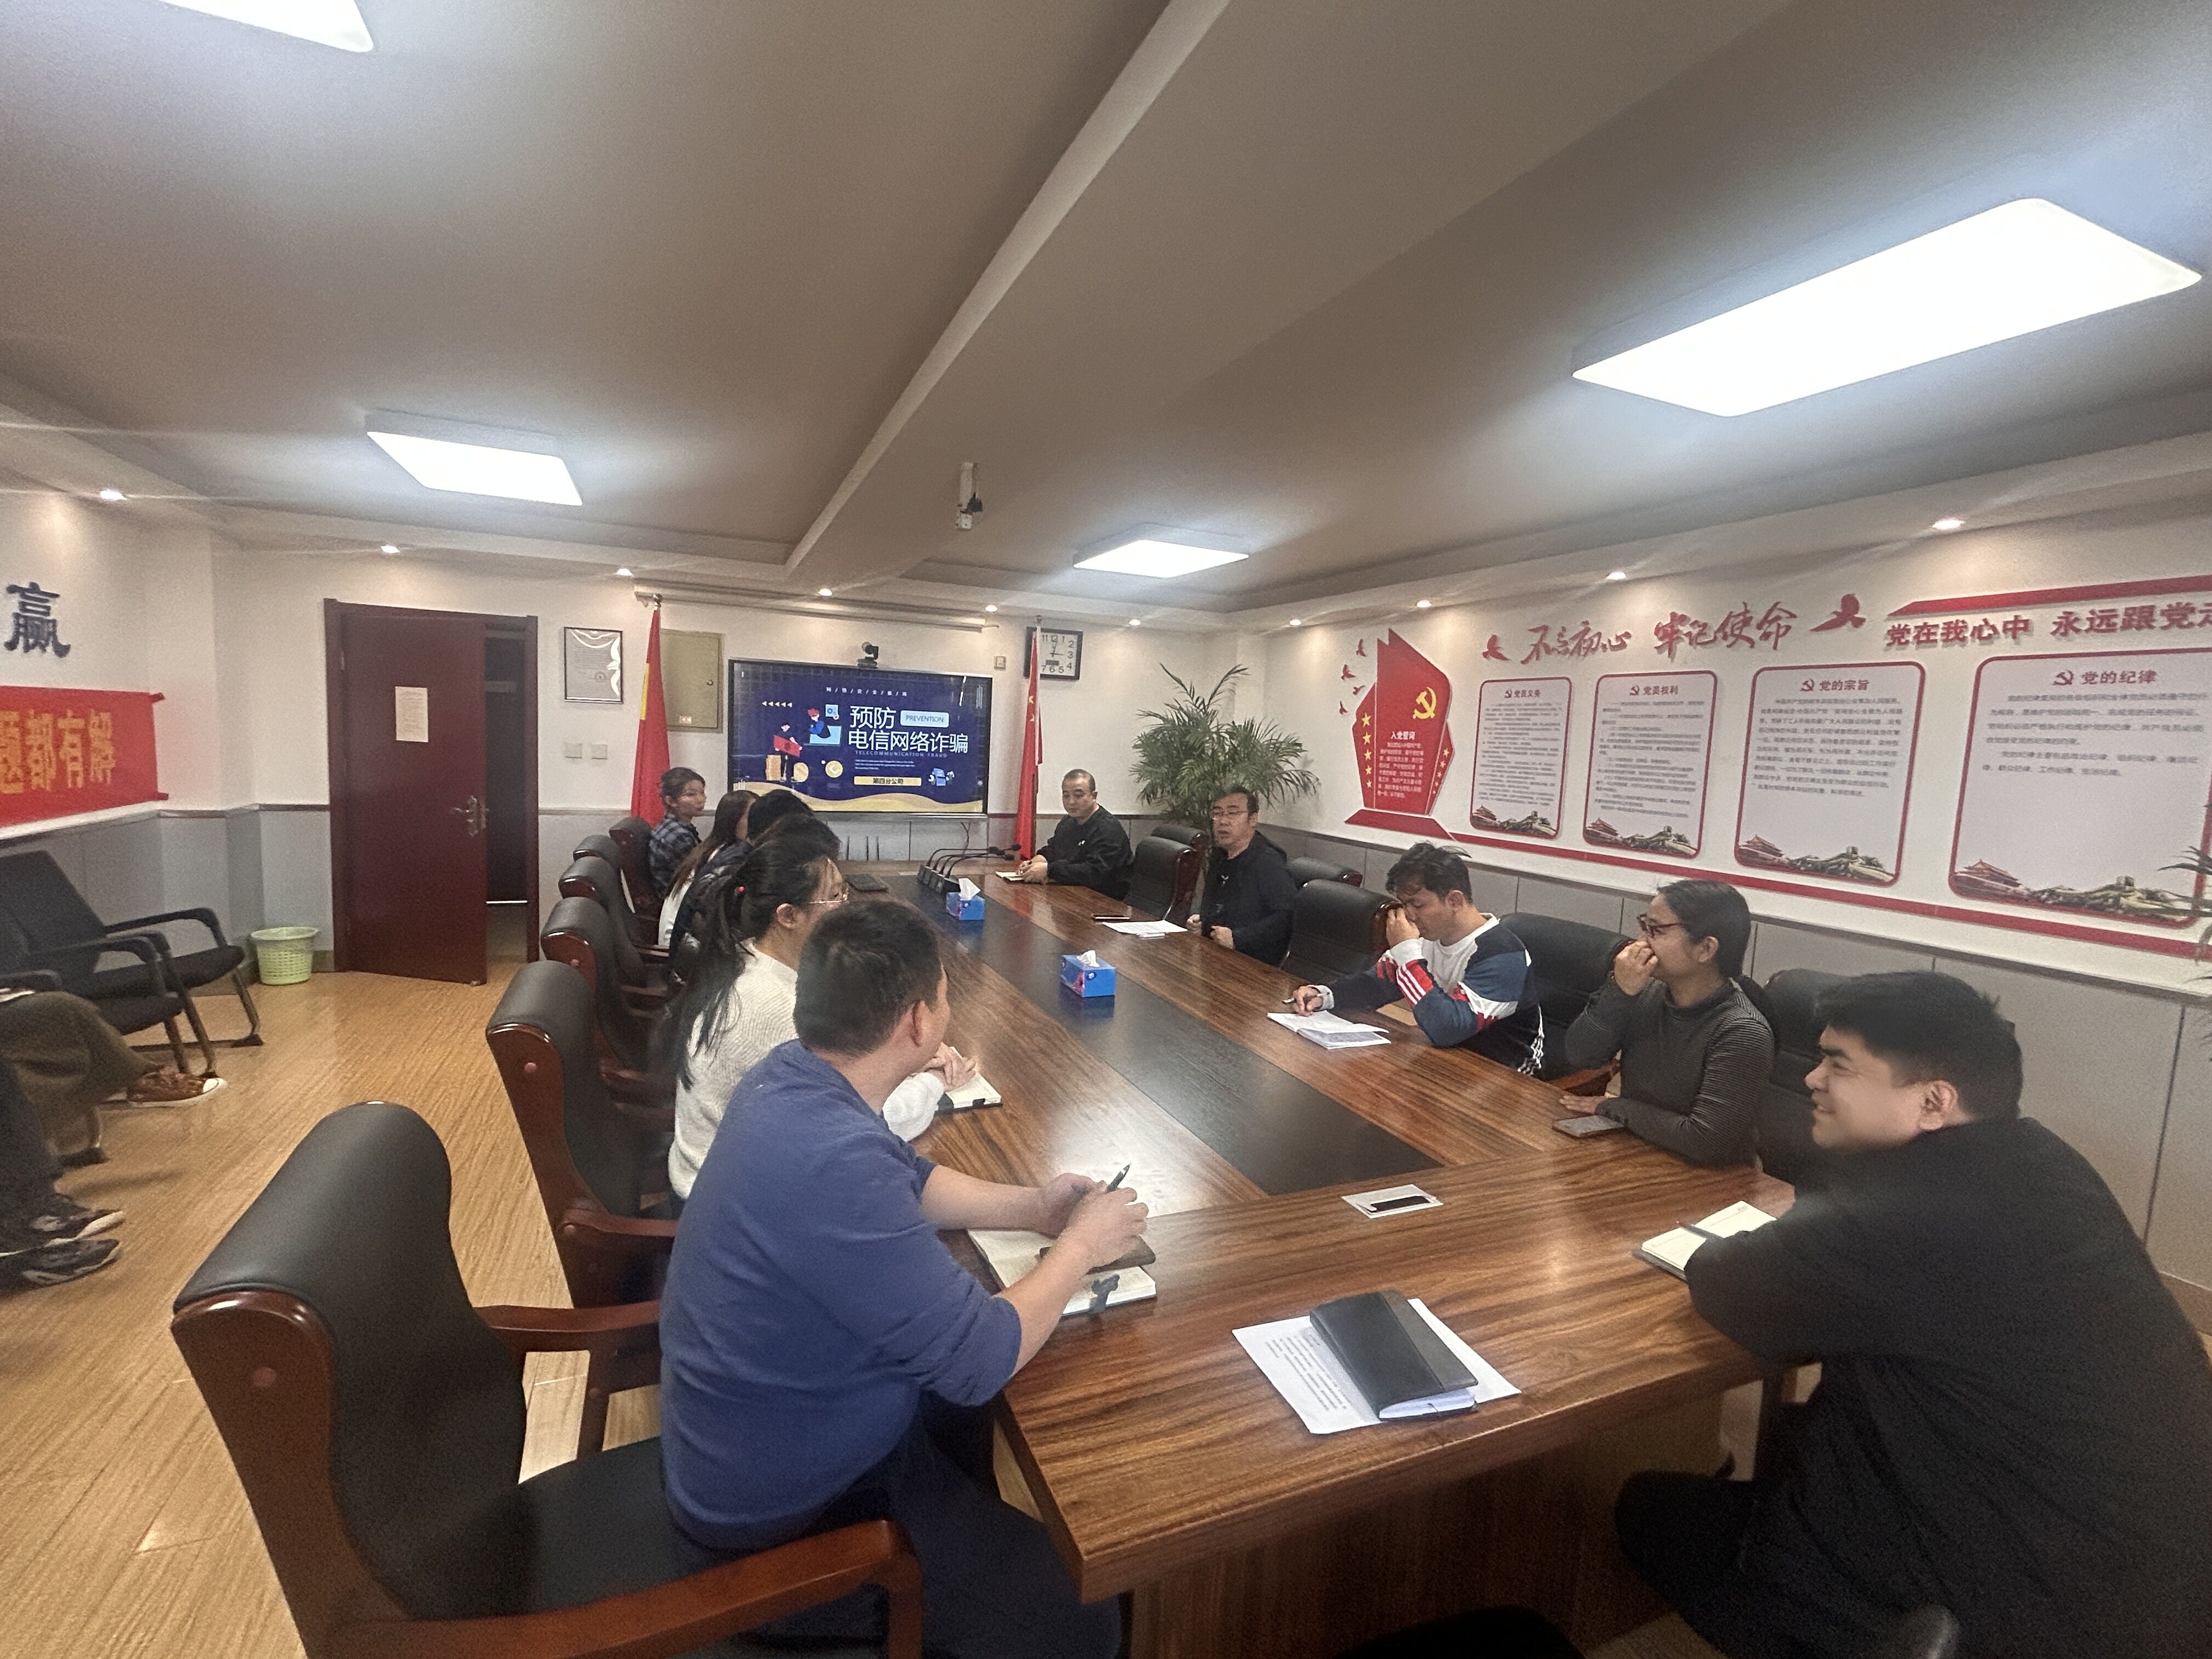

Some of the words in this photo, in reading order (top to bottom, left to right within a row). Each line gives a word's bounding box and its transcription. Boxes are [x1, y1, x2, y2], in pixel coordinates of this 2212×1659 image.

[4, 582, 71, 658] 赢
[1520, 620, 1632, 664] 不忘初心
[1653, 601, 1798, 662] 牢记使命
[1886, 614, 2030, 646] 党在我心中
[1050, 634, 1058, 642] 12
[1068, 640, 1074, 648] 2
[1058, 665, 1064, 674] 5
[2081, 669, 2157, 685] 党的纪律
[1643, 685, 1679, 696] 党员权利
[1819, 679, 1870, 691] 党的宗旨
[850, 706, 896, 729] 预防
[906, 715, 944, 723] PREVENTION
[848, 729, 968, 754] 电信网络诈骗
